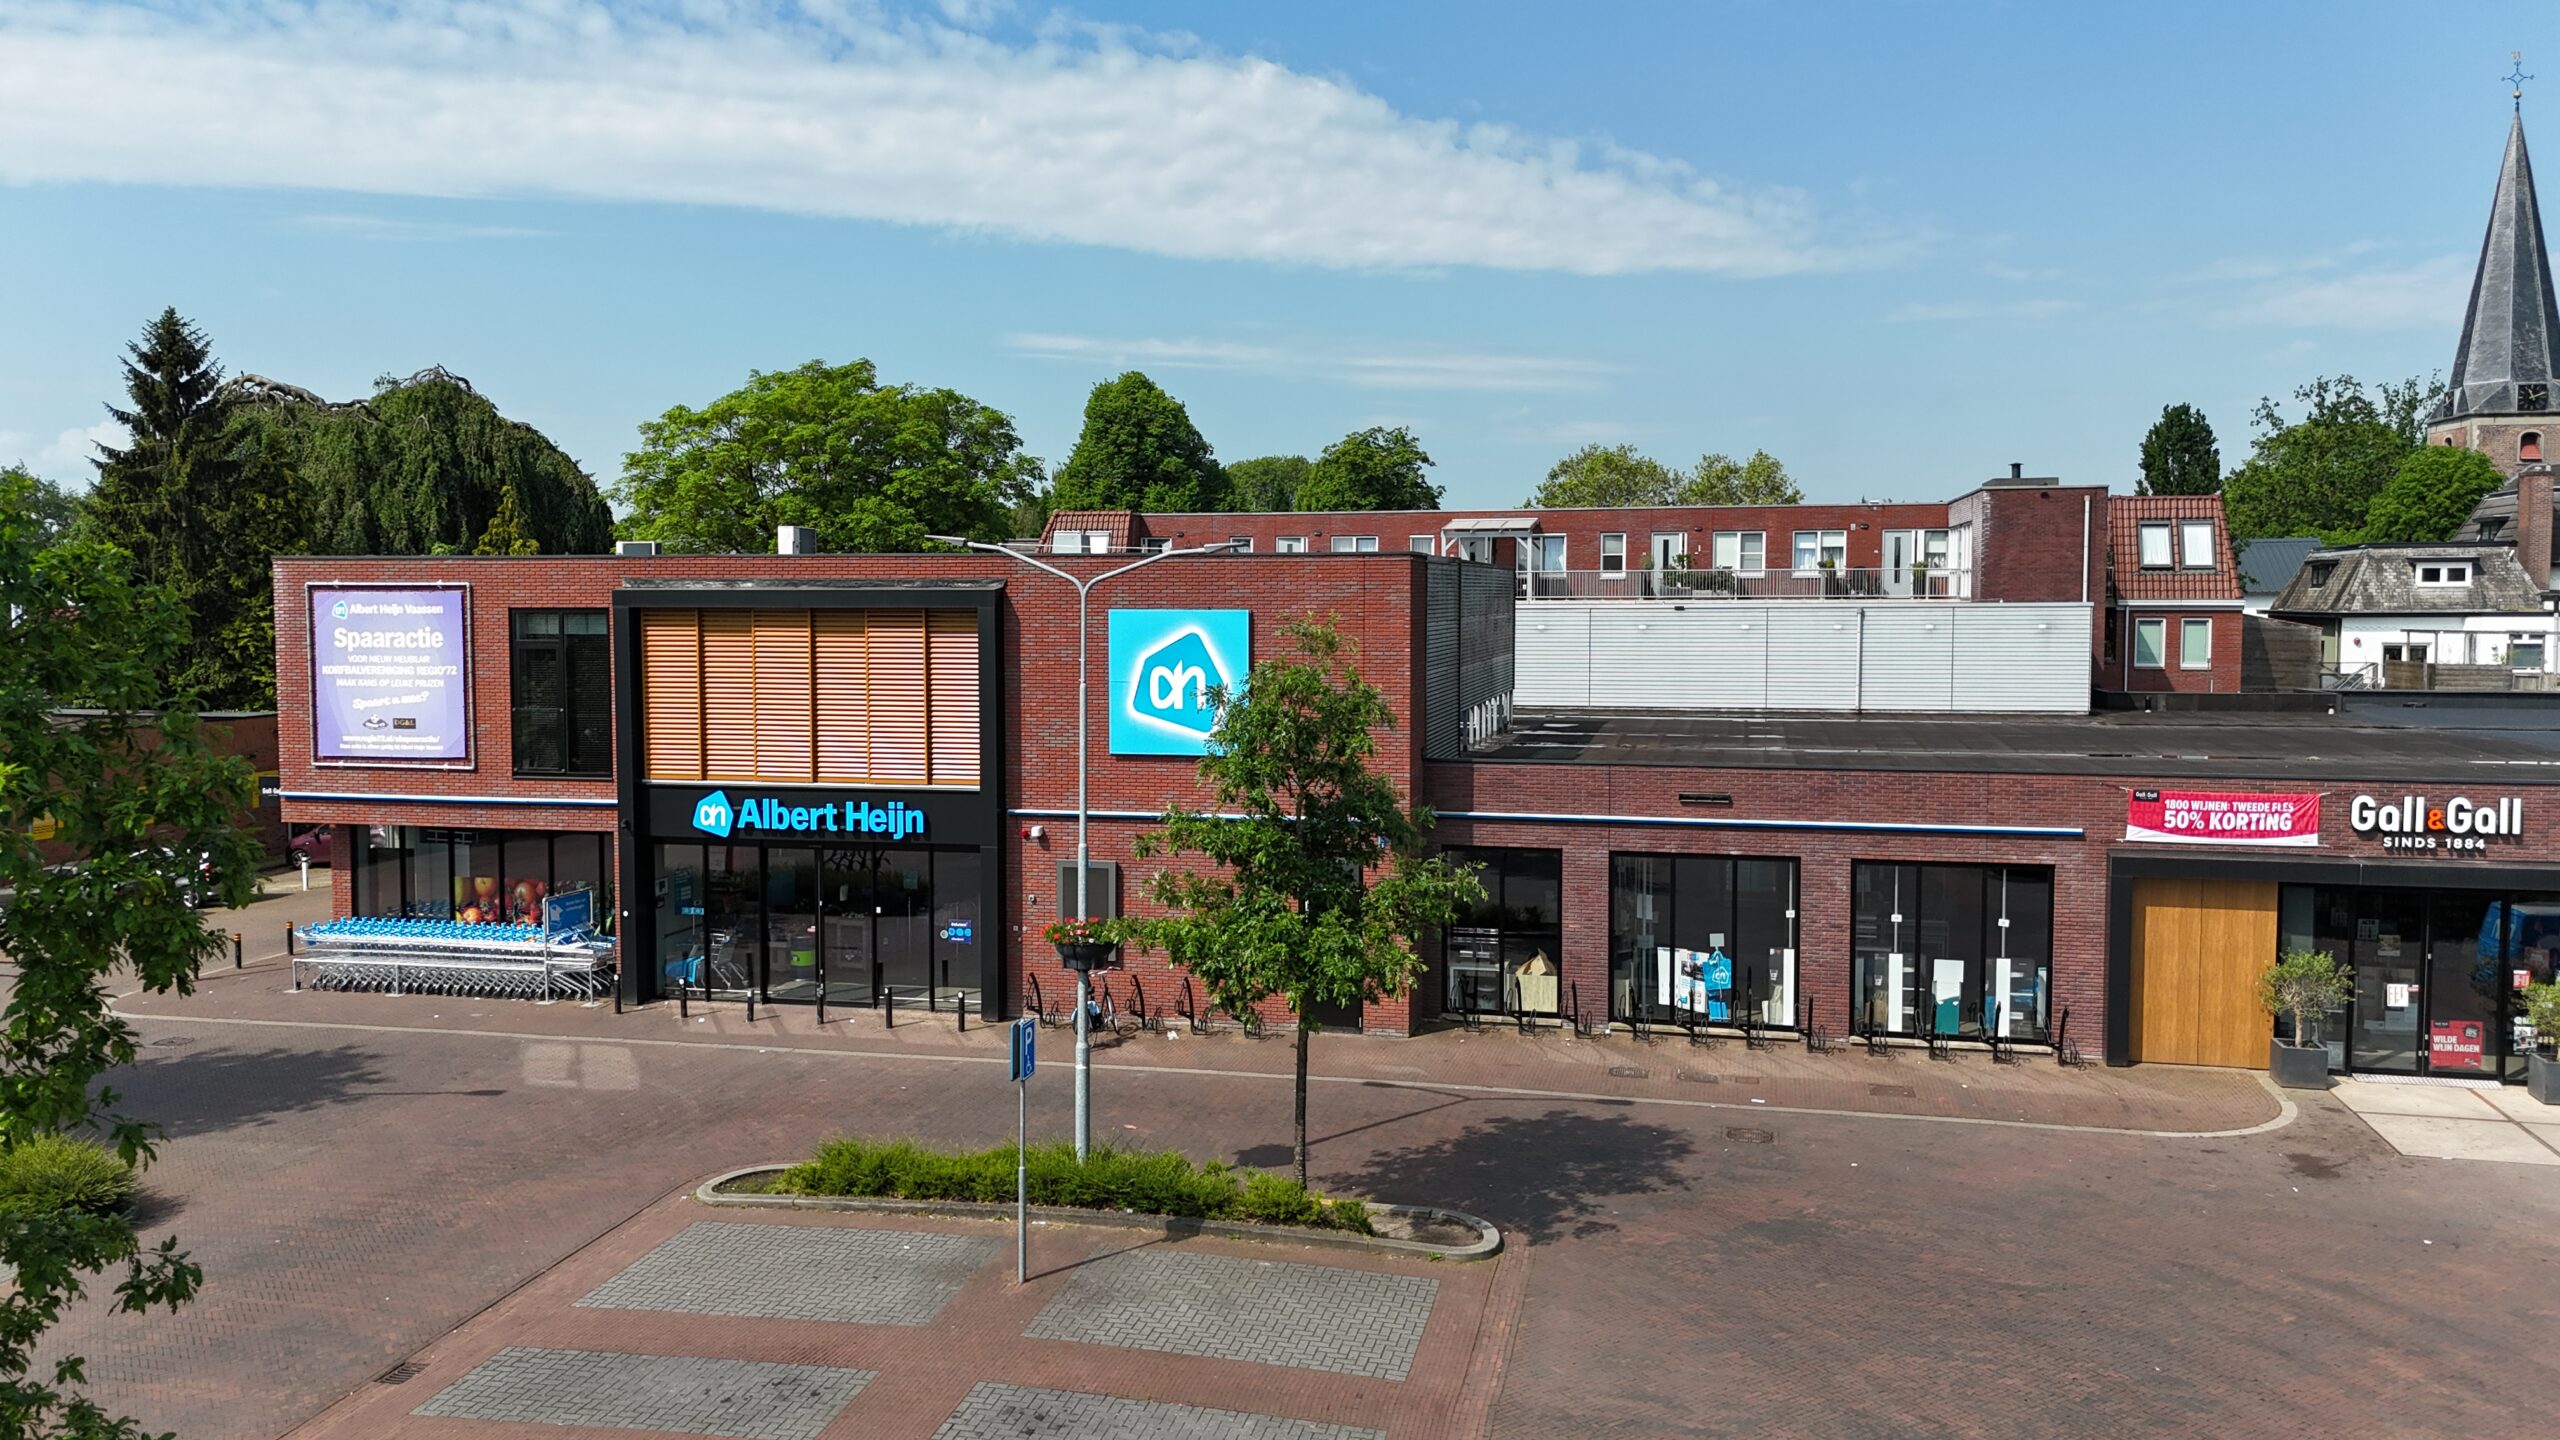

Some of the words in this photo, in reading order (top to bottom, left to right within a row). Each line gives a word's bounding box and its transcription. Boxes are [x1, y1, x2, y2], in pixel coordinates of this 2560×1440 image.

[350, 604, 378, 614] Albert
[380, 604, 403, 616] Heijn
[404, 604, 443, 614] Vaassen
[333, 626, 444, 652] Spaaractie
[348, 655, 368, 663] VOOR
[2164, 799, 2188, 810] 1800
[2190, 800, 2230, 811] WIJNEN:
[2232, 801, 2270, 812] TWEEDE
[2272, 802, 2294, 812] FLES
[737, 798, 838, 832] Albert
[845, 801, 924, 840] Heijn
[2164, 810, 2205, 830] 50%
[2209, 812, 2293, 831] KORTING
[2383, 837, 2436, 849] SINDS
[2445, 838, 2486, 850] 1884
[1025, 1026, 1033, 1056] P
[2433, 1035, 2457, 1044] WILDE
[2454, 1044, 2480, 1053] DAGEN
